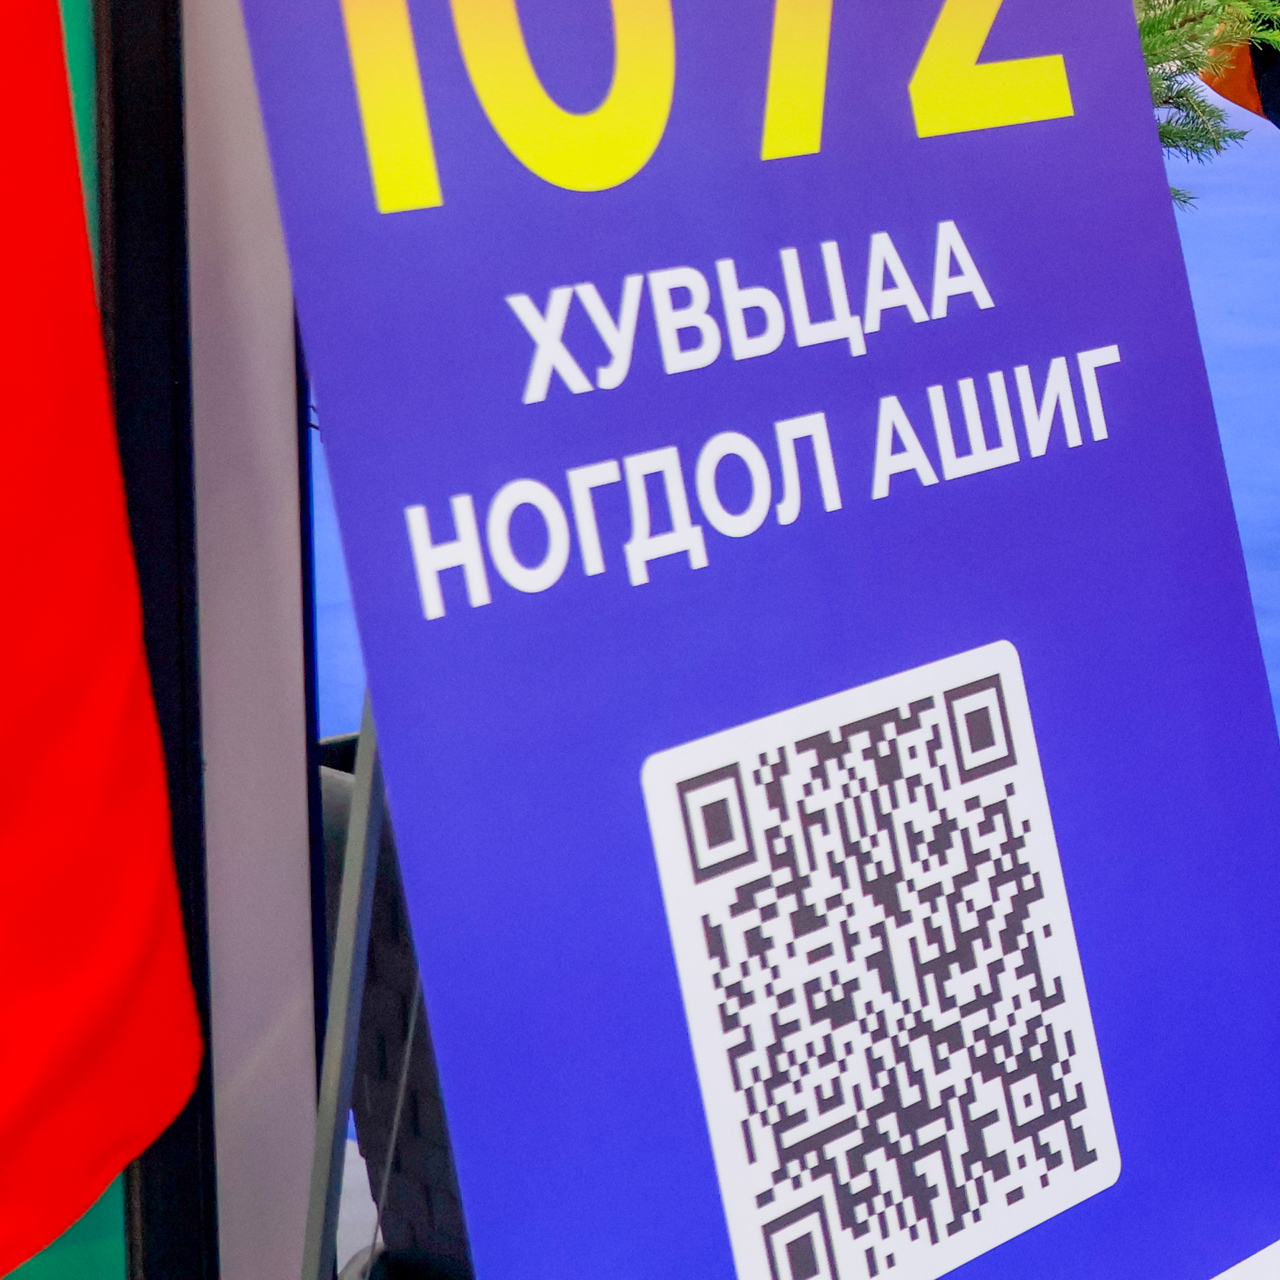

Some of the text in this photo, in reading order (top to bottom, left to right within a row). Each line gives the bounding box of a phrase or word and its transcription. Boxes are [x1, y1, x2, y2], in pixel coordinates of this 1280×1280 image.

[506, 220, 995, 406] ХУВЬЦАА
[404, 344, 1122, 621] НОГДОЛ АШИГ
